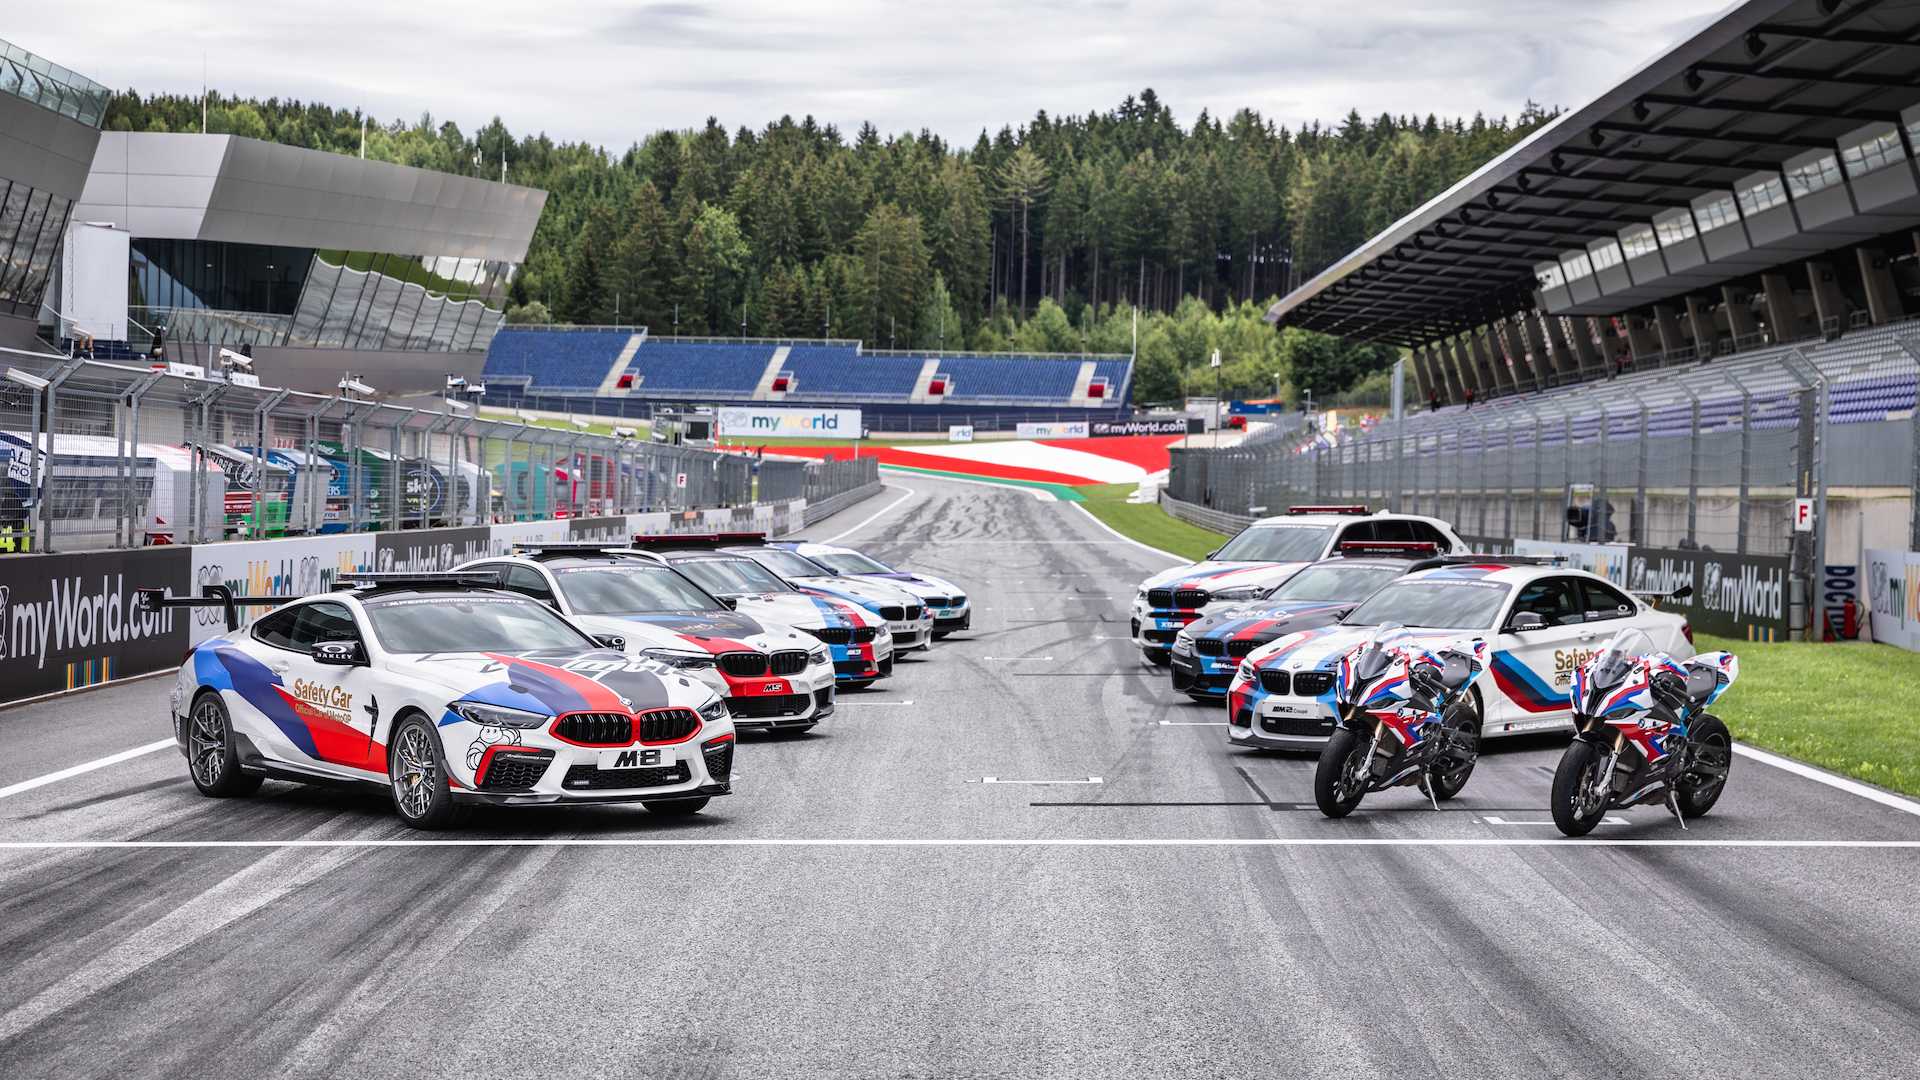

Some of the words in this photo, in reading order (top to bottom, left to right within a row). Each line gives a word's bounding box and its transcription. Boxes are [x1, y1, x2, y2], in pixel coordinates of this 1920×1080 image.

[752, 413, 838, 430] myWorld
[1111, 422, 1186, 434] myWorld.com
[1799, 505, 1808, 524] F
[1720, 564, 1783, 623] myWorld
[11, 573, 174, 669] myWorld.com
[294, 678, 331, 708] Safety
[331, 685, 353, 709] Car
[763, 683, 783, 692] M5
[613, 750, 661, 768] M8
